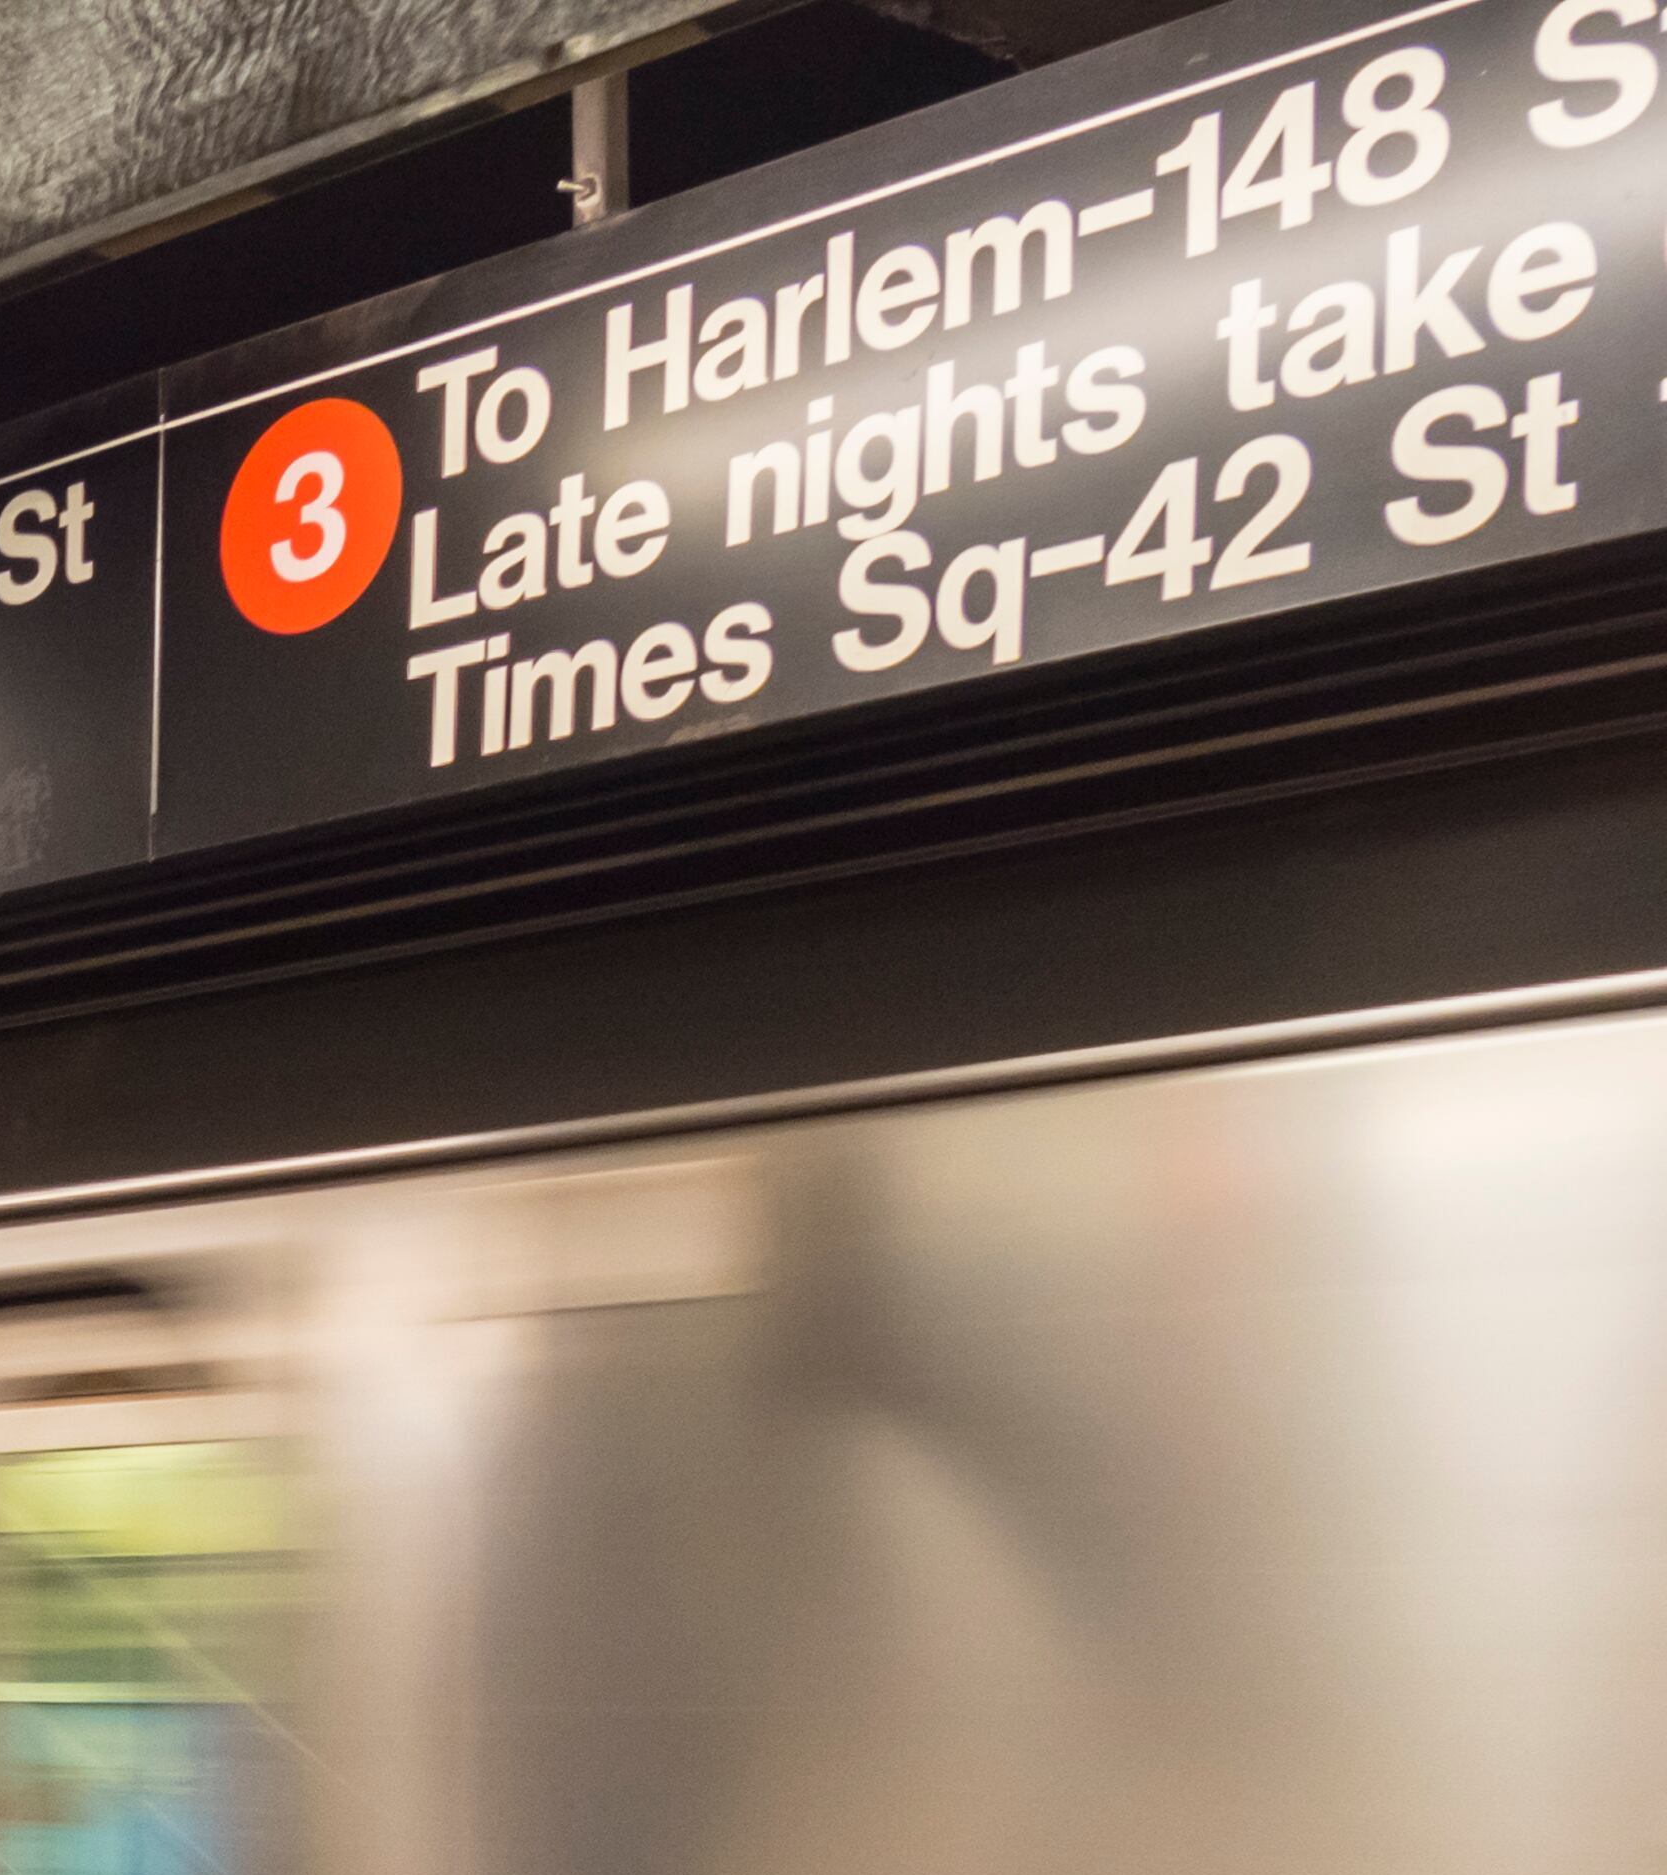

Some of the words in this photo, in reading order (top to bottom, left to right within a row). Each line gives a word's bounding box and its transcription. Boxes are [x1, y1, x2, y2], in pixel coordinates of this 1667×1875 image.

[407, 479, 670, 631] Late
[724, 344, 1147, 544] nights
[1216, 221, 1597, 412] take
[416, 345, 553, 481] To
[602, 46, 1450, 430] Harlem-148
[1527, 0, 1667, 149] S
[269, 449, 347, 584] 3
[407, 602, 774, 769] Times
[832, 434, 1313, 673] Sq-42
[1384, 372, 1579, 546] St
